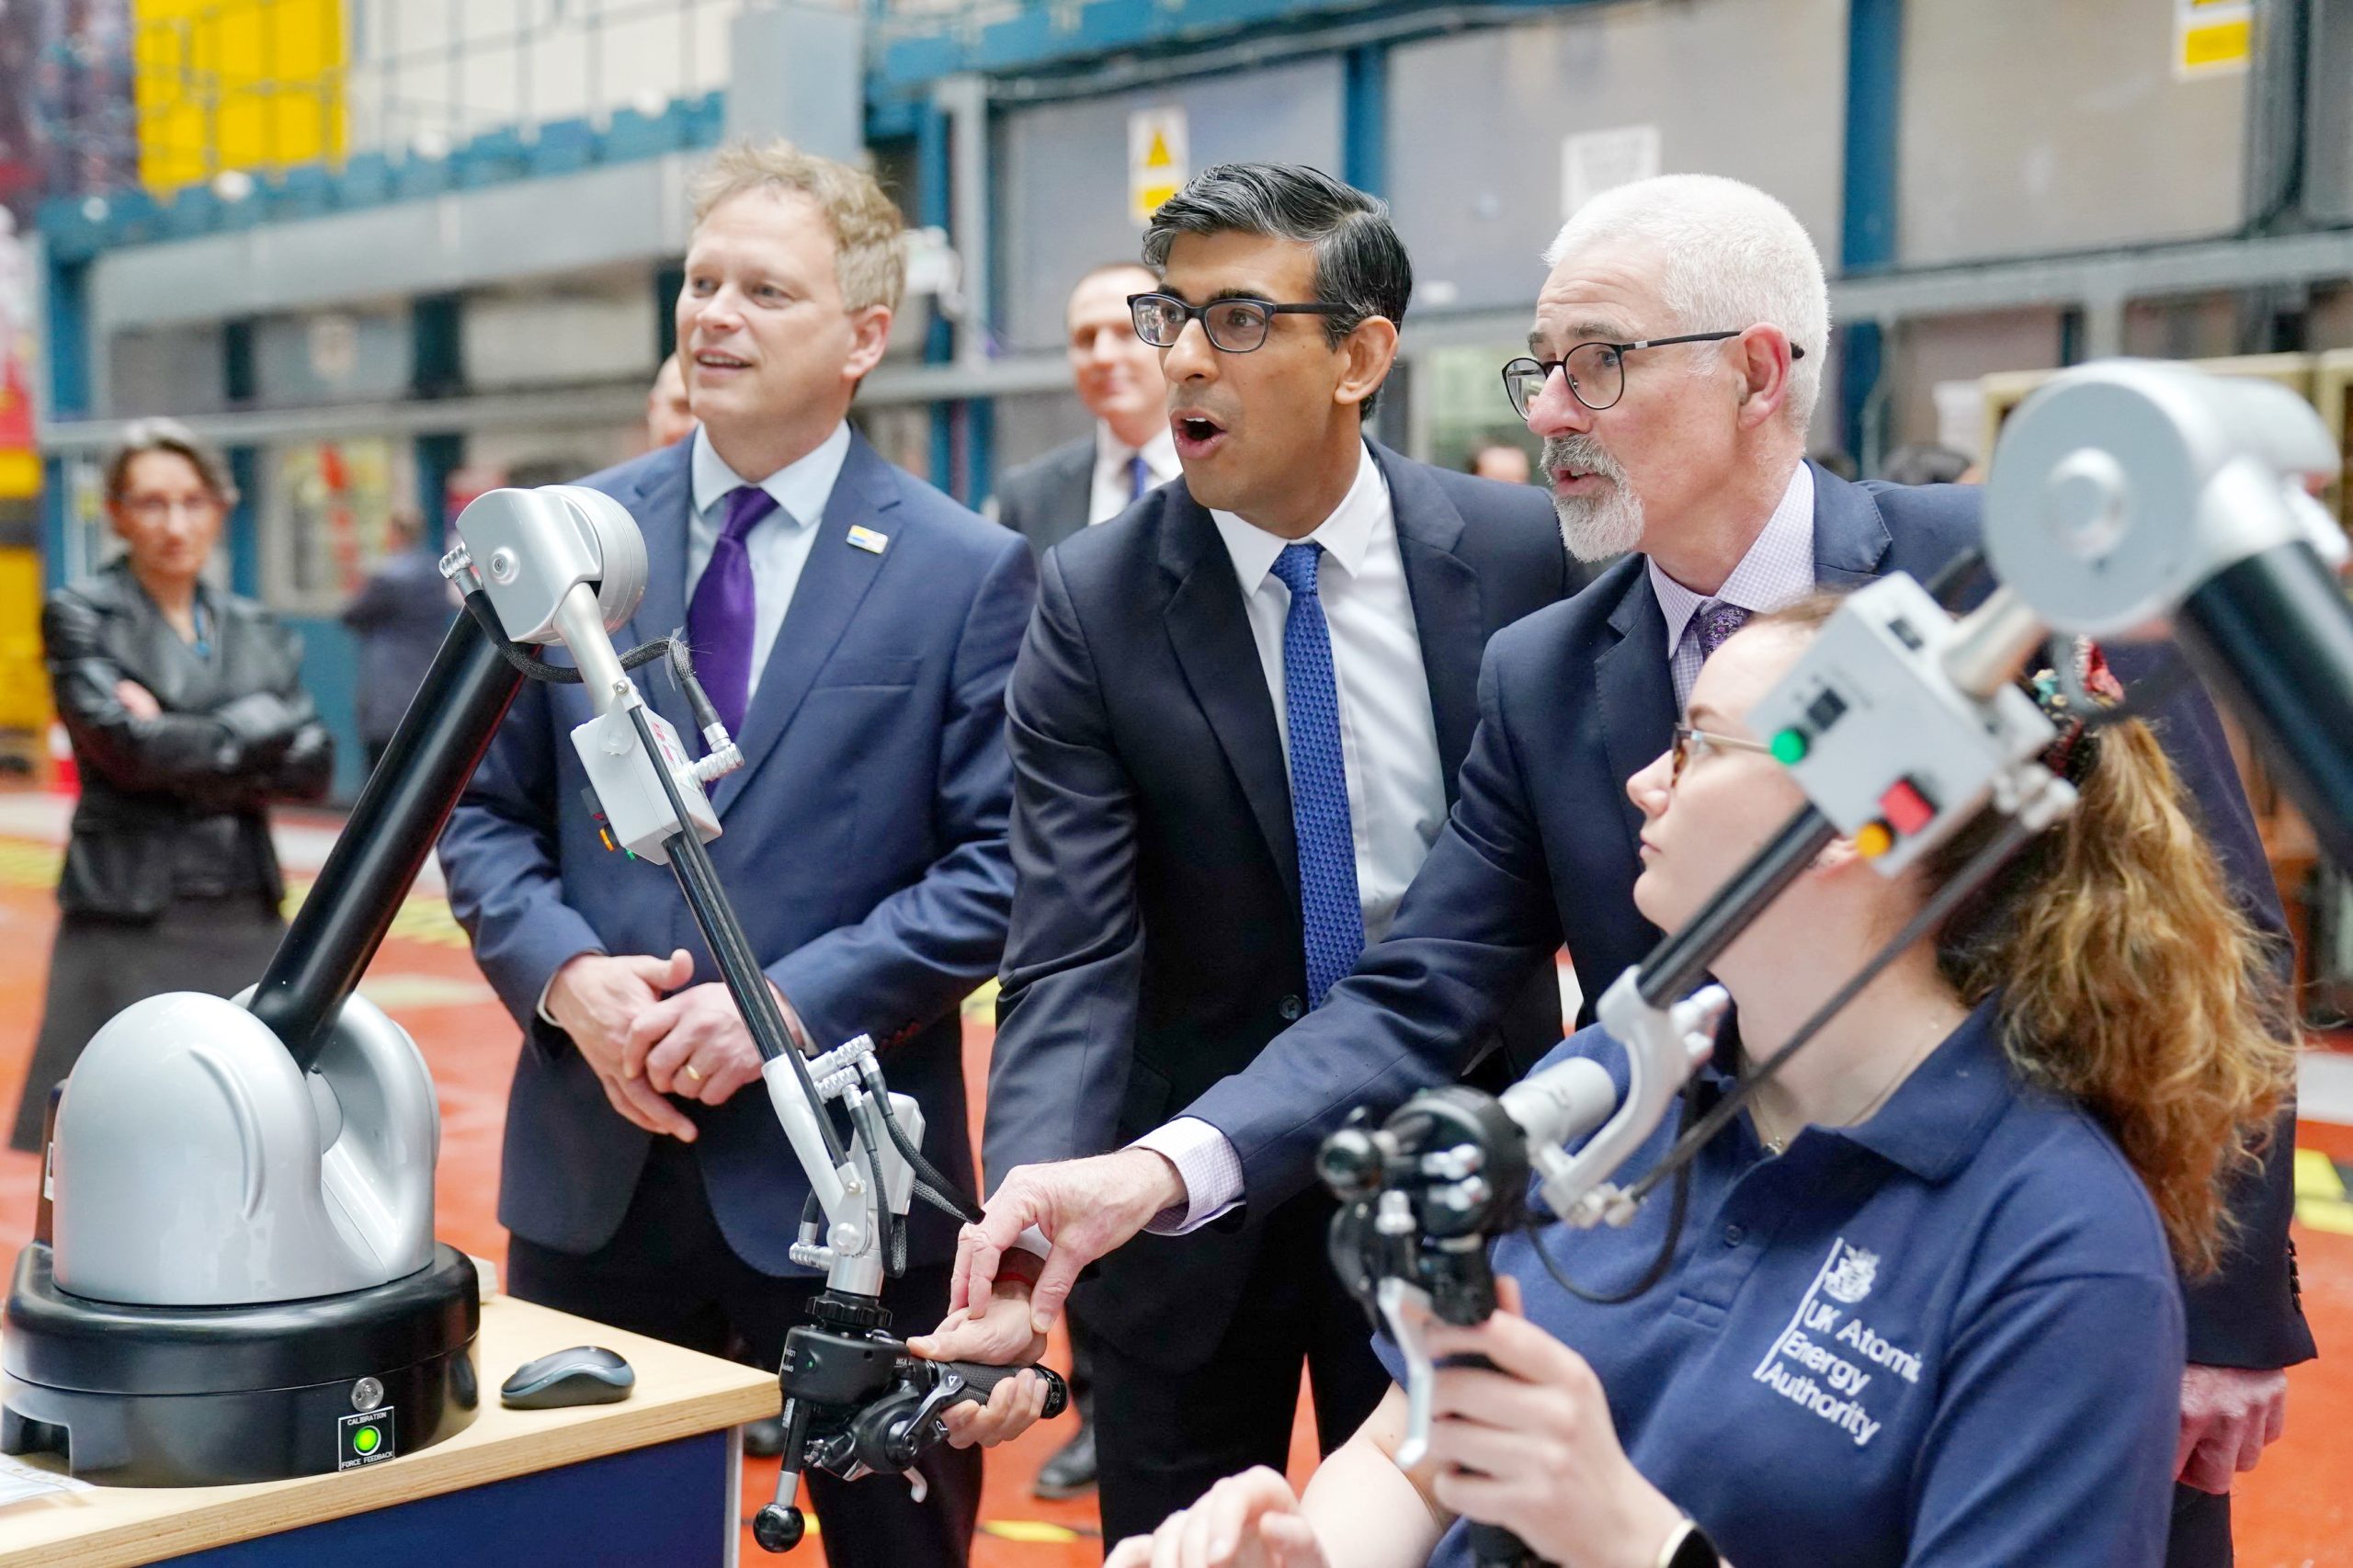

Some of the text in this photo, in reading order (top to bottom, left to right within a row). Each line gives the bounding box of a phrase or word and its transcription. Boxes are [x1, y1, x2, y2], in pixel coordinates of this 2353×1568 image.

[1781, 1330, 1871, 1396] Energy
[1803, 1299, 1923, 1383] UK Atomi
[347, 1412, 387, 1426] CALIBRATION
[1759, 1361, 1881, 1446] Authority
[342, 1451, 393, 1469] FORCE FEEDBACK
